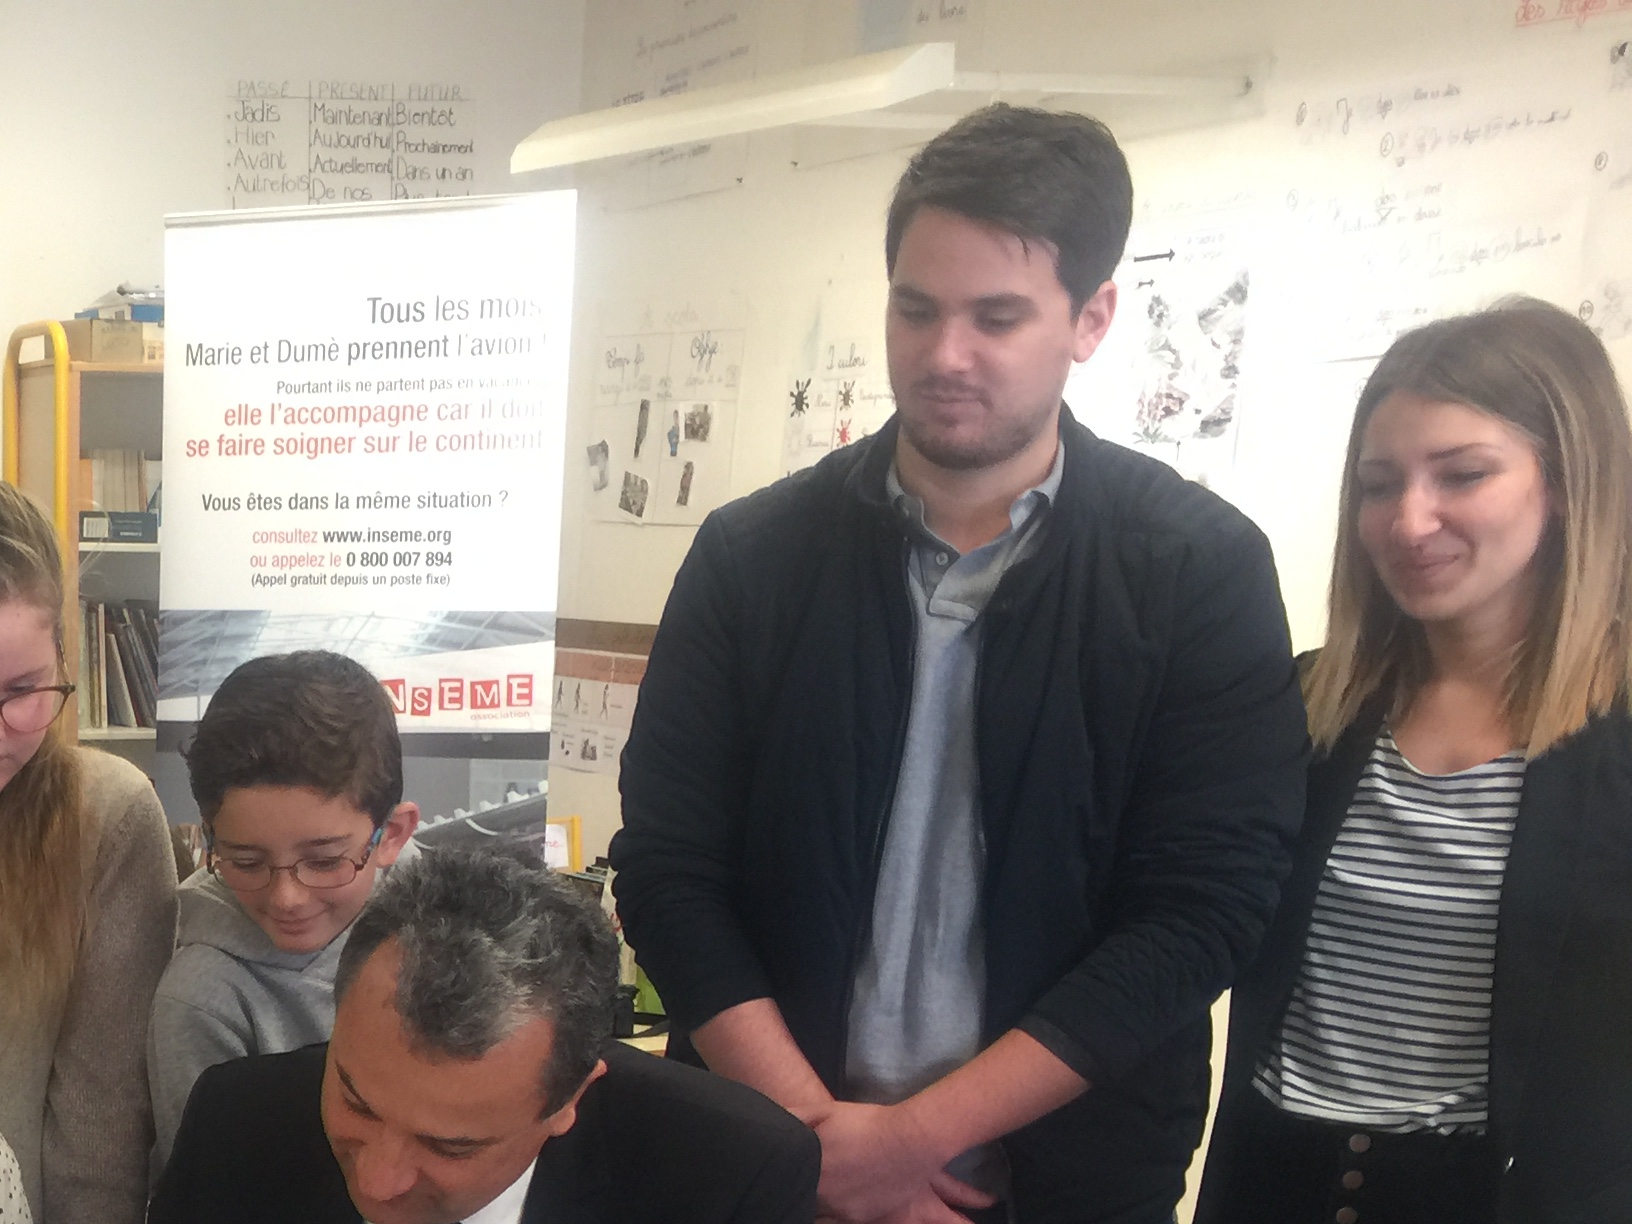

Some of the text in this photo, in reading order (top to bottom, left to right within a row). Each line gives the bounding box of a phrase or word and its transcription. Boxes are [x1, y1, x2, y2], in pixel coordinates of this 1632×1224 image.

[234, 101, 280, 123] Jadis
[313, 103, 391, 127] Maintenant
[396, 103, 456, 127] Bientôt
[234, 127, 276, 145] Hier
[313, 129, 391, 151] Aujourd'hui
[396, 130, 474, 155] Prochainement
[234, 148, 287, 170] Avant
[313, 154, 392, 175] Actuellement
[396, 157, 474, 181] Dans un an
[234, 173, 310, 193] Autrefois
[312, 178, 372, 200] De nos
[367, 295, 542, 324] Tous les mois
[185, 343, 242, 367] Marie
[249, 342, 269, 364] et
[278, 337, 339, 364] Dumè
[347, 335, 449, 366] prennent
[457, 332, 532, 357] l'avion
[276, 380, 332, 395] Pourtant
[337, 379, 351, 393] ils
[355, 382, 372, 393] ne
[376, 377, 425, 394] partent
[429, 379, 453, 393] pas
[457, 379, 473, 389] en
[224, 397, 543, 428] elle l'accompagne car il doit
[186, 429, 543, 459] se faire soigner sur le continent
[202, 490, 509, 511] Vous êtes dans la même situation ?
[252, 528, 452, 547] consultez www.inseme.org
[250, 550, 453, 571] ou appelez le 0 800 007 894
[251, 571, 451, 587] (Appel gratuit depuis un poste fixe)
[382, 675, 533, 716] NSEME
